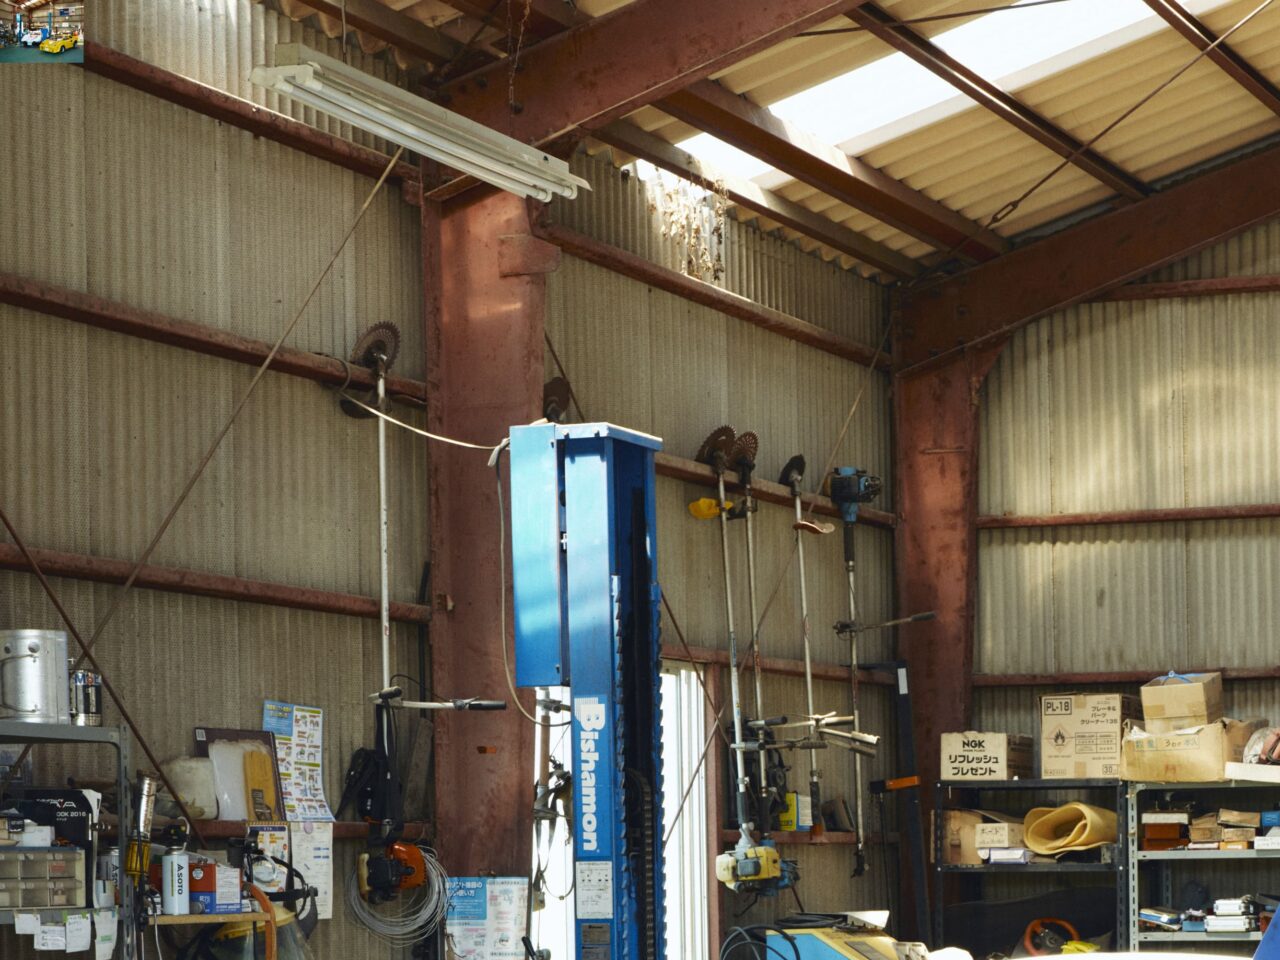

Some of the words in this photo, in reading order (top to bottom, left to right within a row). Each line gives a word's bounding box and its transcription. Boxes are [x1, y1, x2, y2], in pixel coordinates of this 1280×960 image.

[962, 739, 985, 749] NGK
[949, 754, 999, 764] リフレッシュ
[576, 699, 606, 851] Bishamon
